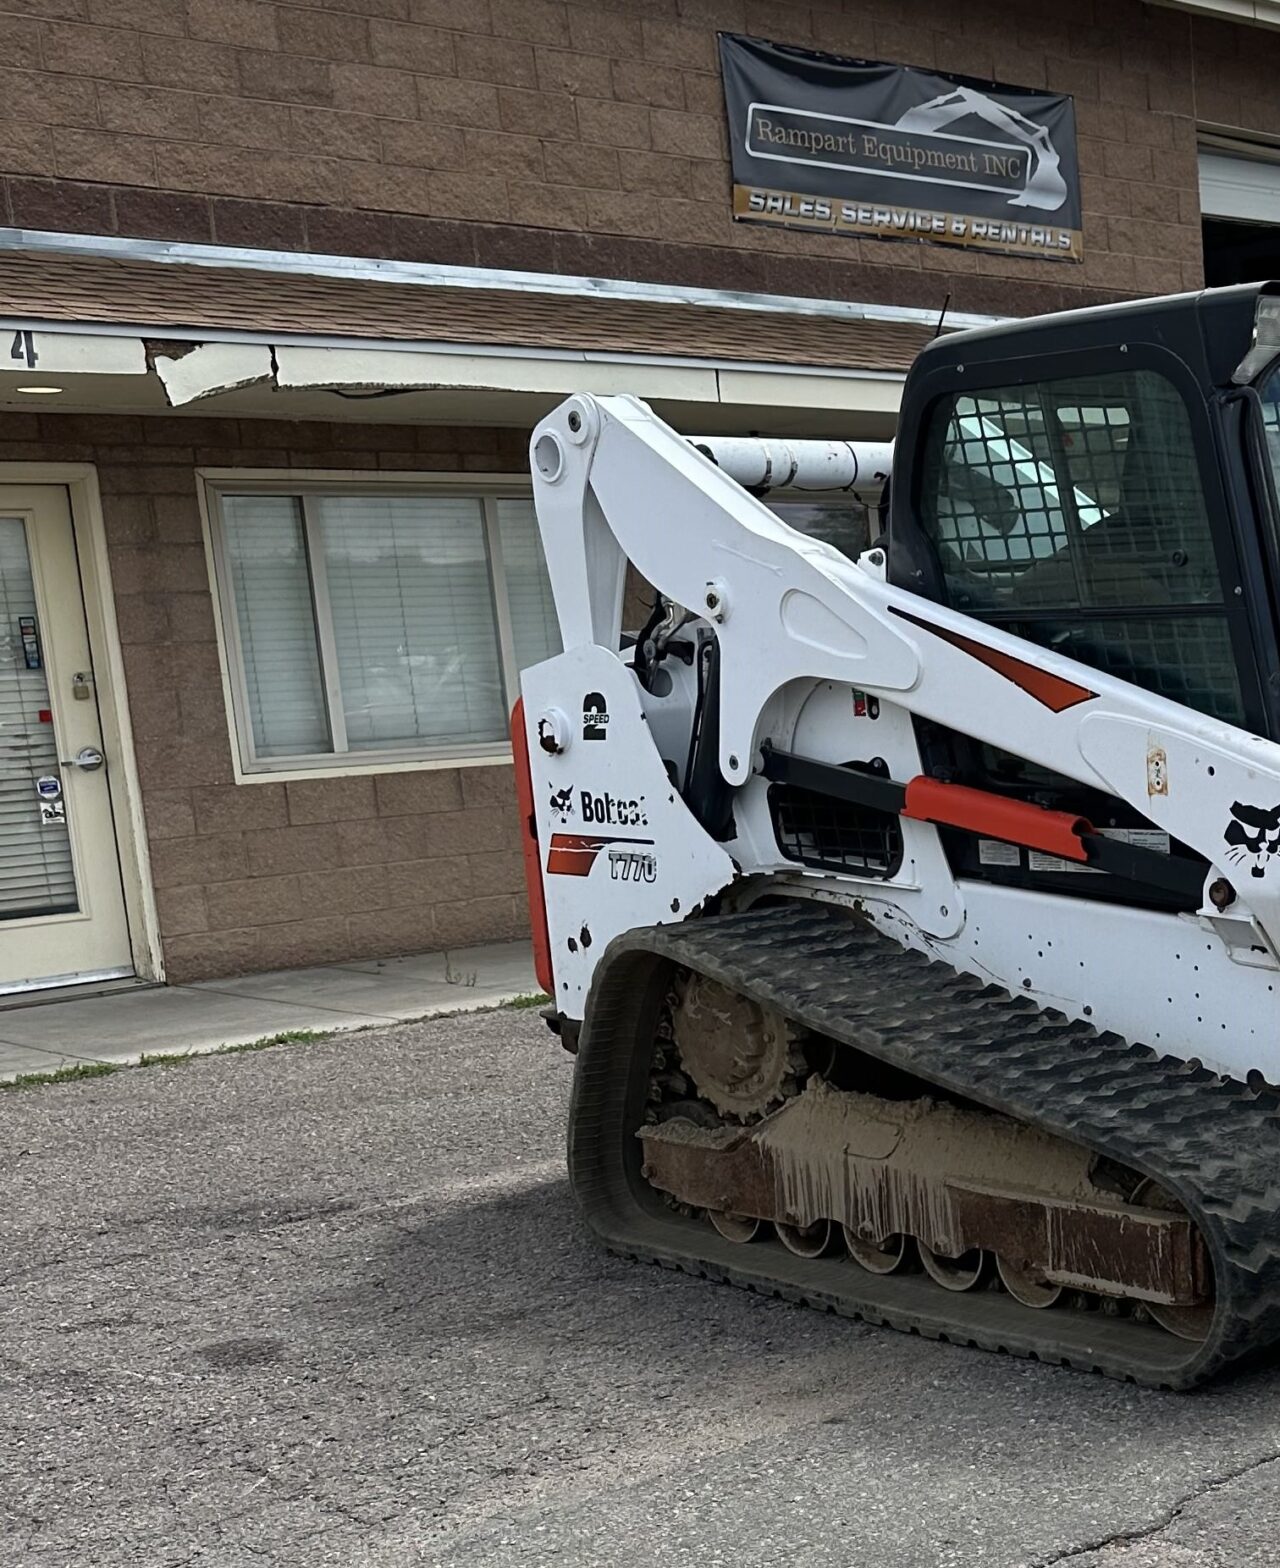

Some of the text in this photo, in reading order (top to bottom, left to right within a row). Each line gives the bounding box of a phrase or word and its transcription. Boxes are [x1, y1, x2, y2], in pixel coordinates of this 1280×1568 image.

[756, 118, 1021, 179] Rampart Equipment INC
[748, 189, 1072, 250] SALES, SERVICE & RENTALS
[10, 330, 39, 369] 4
[583, 713, 609, 724] SPEED
